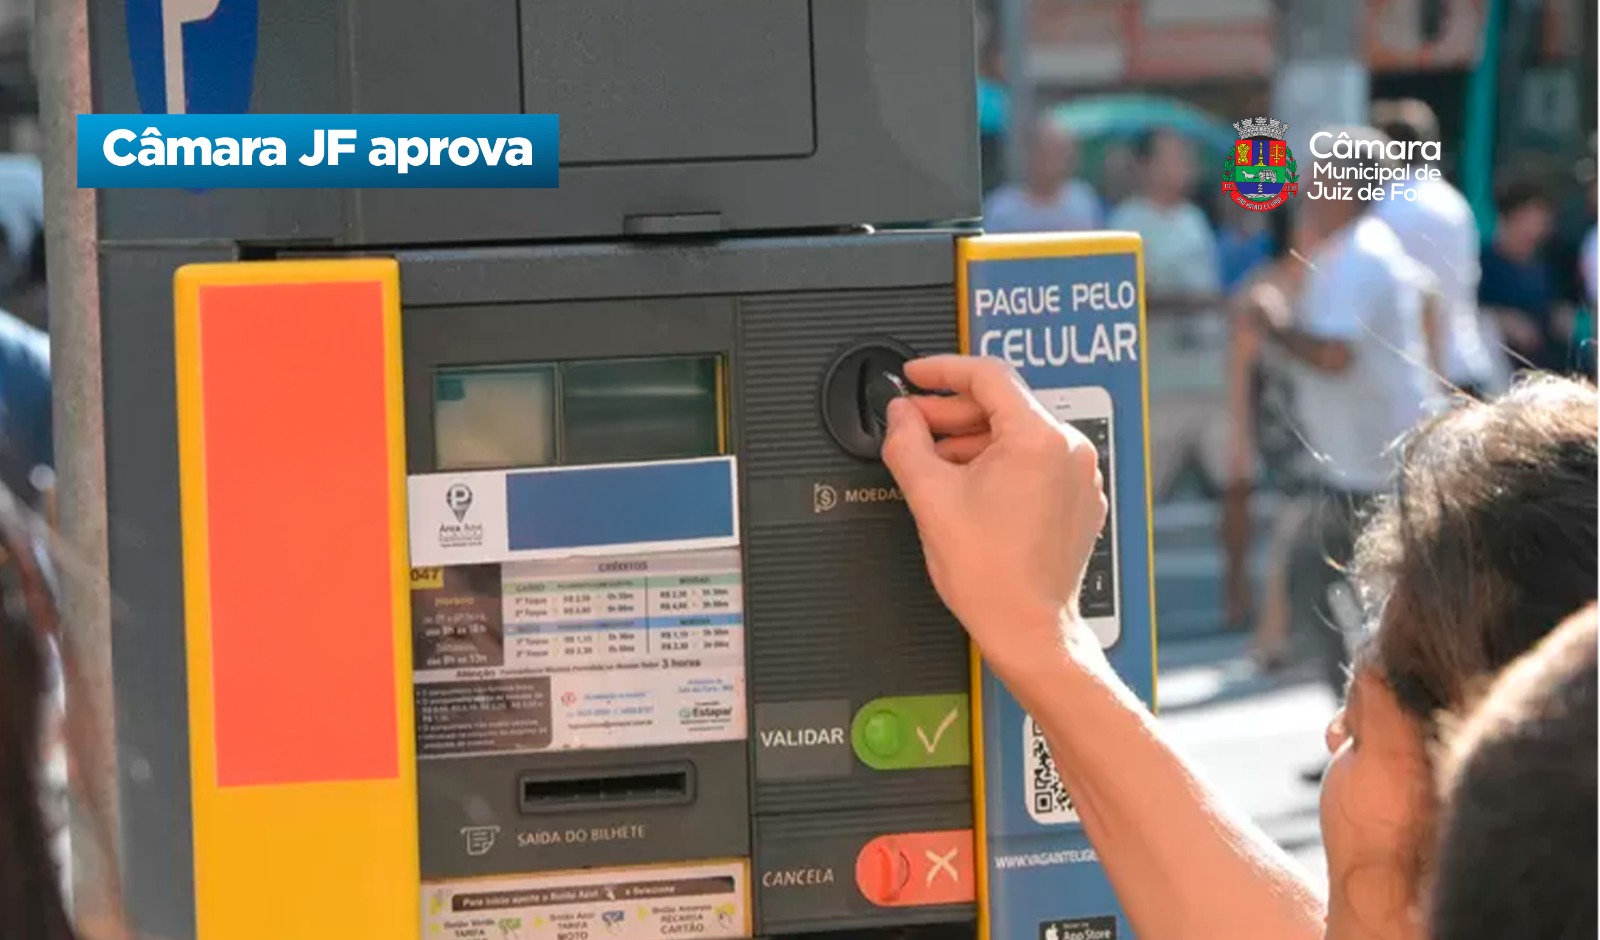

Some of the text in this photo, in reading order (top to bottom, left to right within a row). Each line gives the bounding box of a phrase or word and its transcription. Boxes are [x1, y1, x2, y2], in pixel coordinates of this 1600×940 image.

[975, 281, 1135, 317] PAGUE PELO
[980, 323, 1138, 367] CELULAR
[662, 659, 668, 669] 3
[671, 658, 701, 668] horas
[692, 706, 733, 718] Estapar
[760, 726, 845, 747] VALIDAR
[517, 824, 646, 847] SAÍDA DO BILHETE
[762, 867, 835, 888] CANCELA
[557, 921, 588, 930] TARIFA
[660, 922, 704, 935] CARTÃO
[557, 931, 588, 940] MOTO
[1085, 928, 1112, 940] Store
